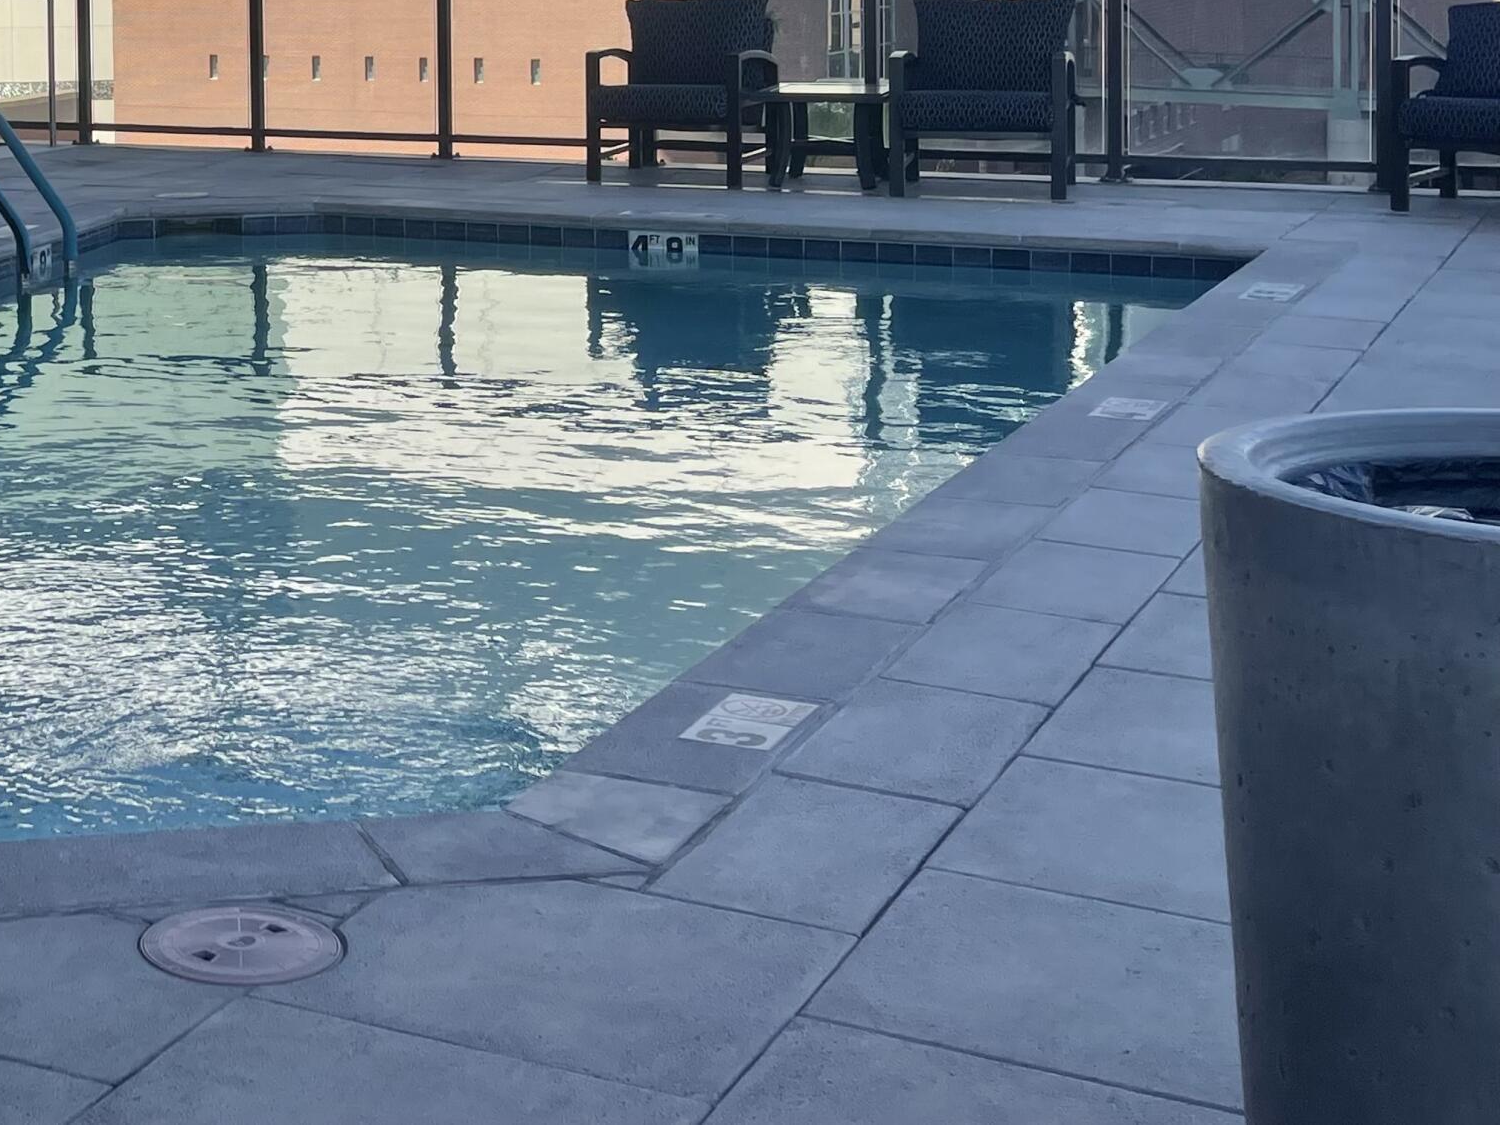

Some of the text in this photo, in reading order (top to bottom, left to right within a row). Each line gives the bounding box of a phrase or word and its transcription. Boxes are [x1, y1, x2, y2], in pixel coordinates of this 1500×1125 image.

[649, 234, 660, 244] FT
[685, 236, 696, 245] IN
[696, 728, 768, 747] 3
